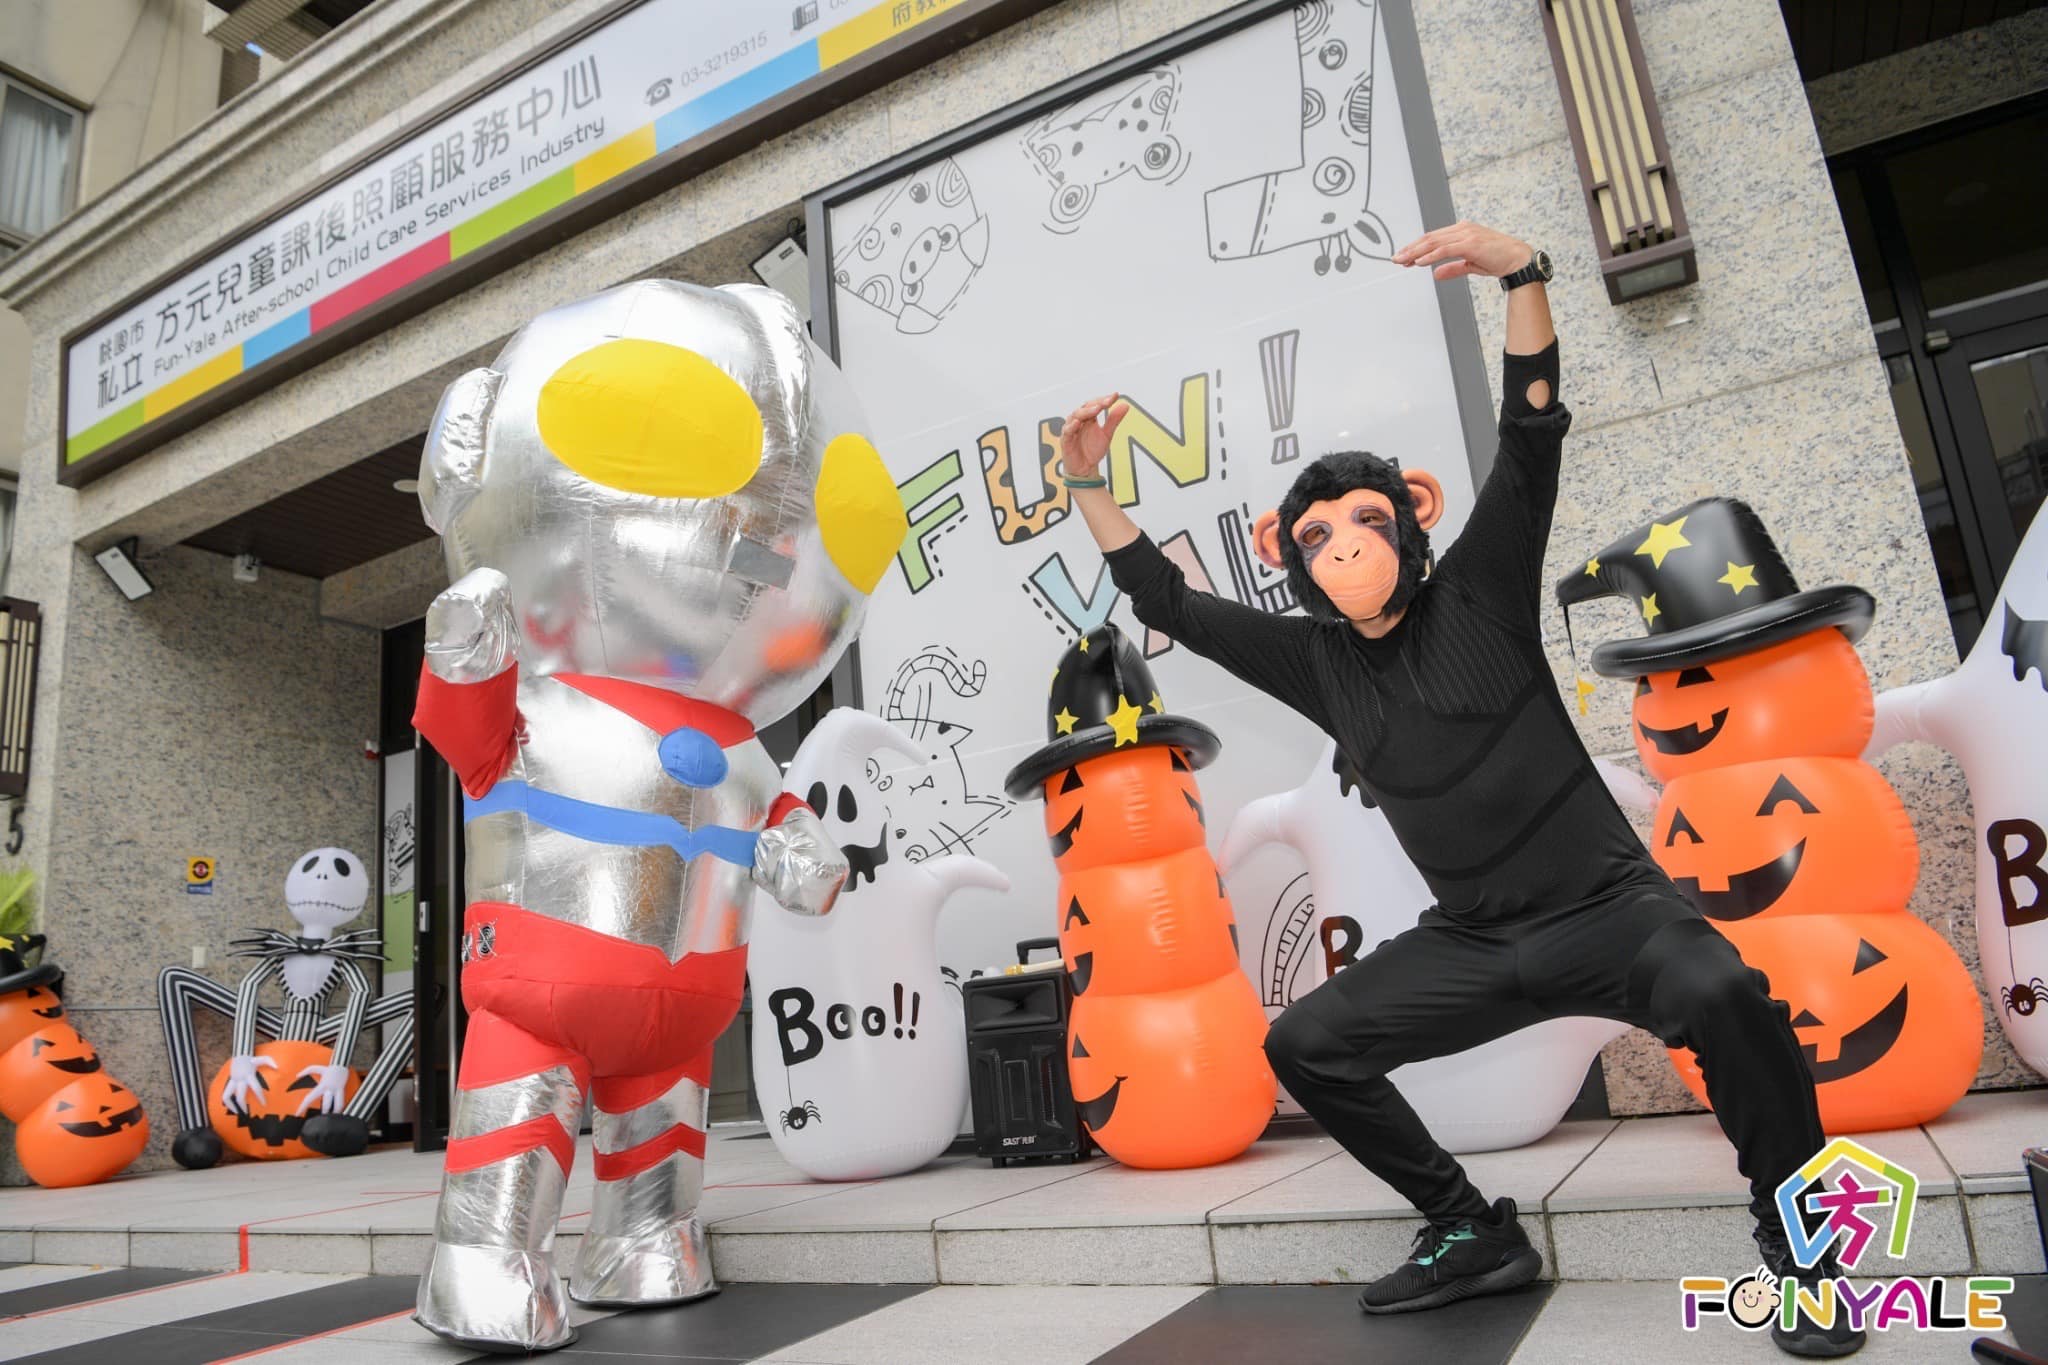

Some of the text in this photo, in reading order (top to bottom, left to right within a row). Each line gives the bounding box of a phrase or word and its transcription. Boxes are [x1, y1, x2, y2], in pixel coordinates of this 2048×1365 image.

[680, 31, 768, 87] 03-3219315
[155, 55, 602, 349] 方元兒童課後照顧服務中心
[153, 116, 605, 377] Fun-Yale After-school Child Care Services Industry
[98, 319, 144, 366] 桃園市
[97, 353, 143, 409] 私立
[768, 982, 921, 1066] Boo!!
